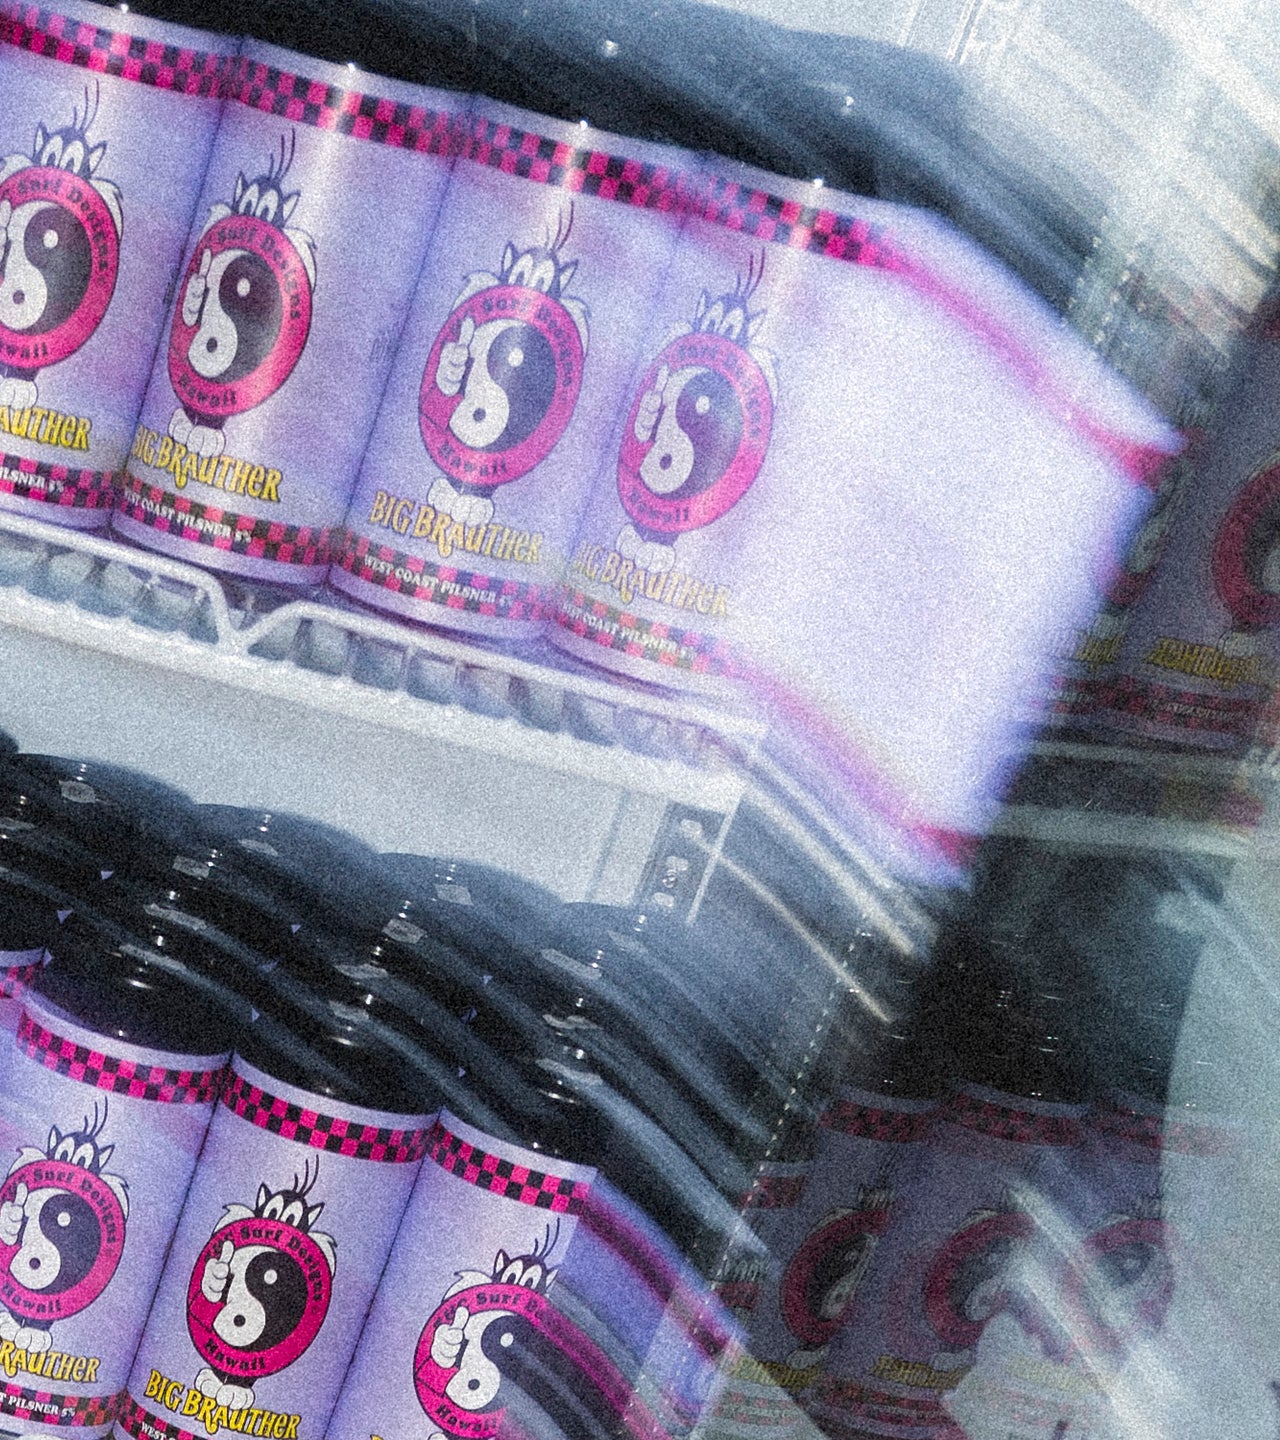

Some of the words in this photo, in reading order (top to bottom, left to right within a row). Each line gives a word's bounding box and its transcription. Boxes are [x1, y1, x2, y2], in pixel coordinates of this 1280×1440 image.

[155, 434, 284, 503] BRAUTHER
[370, 488, 415, 536] BIG
[414, 502, 545, 566] BRAUTHER
[240, 1225, 284, 1241] Surf
[287, 1234, 324, 1302] Designs
[204, 1336, 268, 1371] Hawaii
[8, 1391, 59, 1416] PILSNER
[142, 1367, 184, 1414] BIG
[181, 1387, 303, 1440] BRAUTHER
